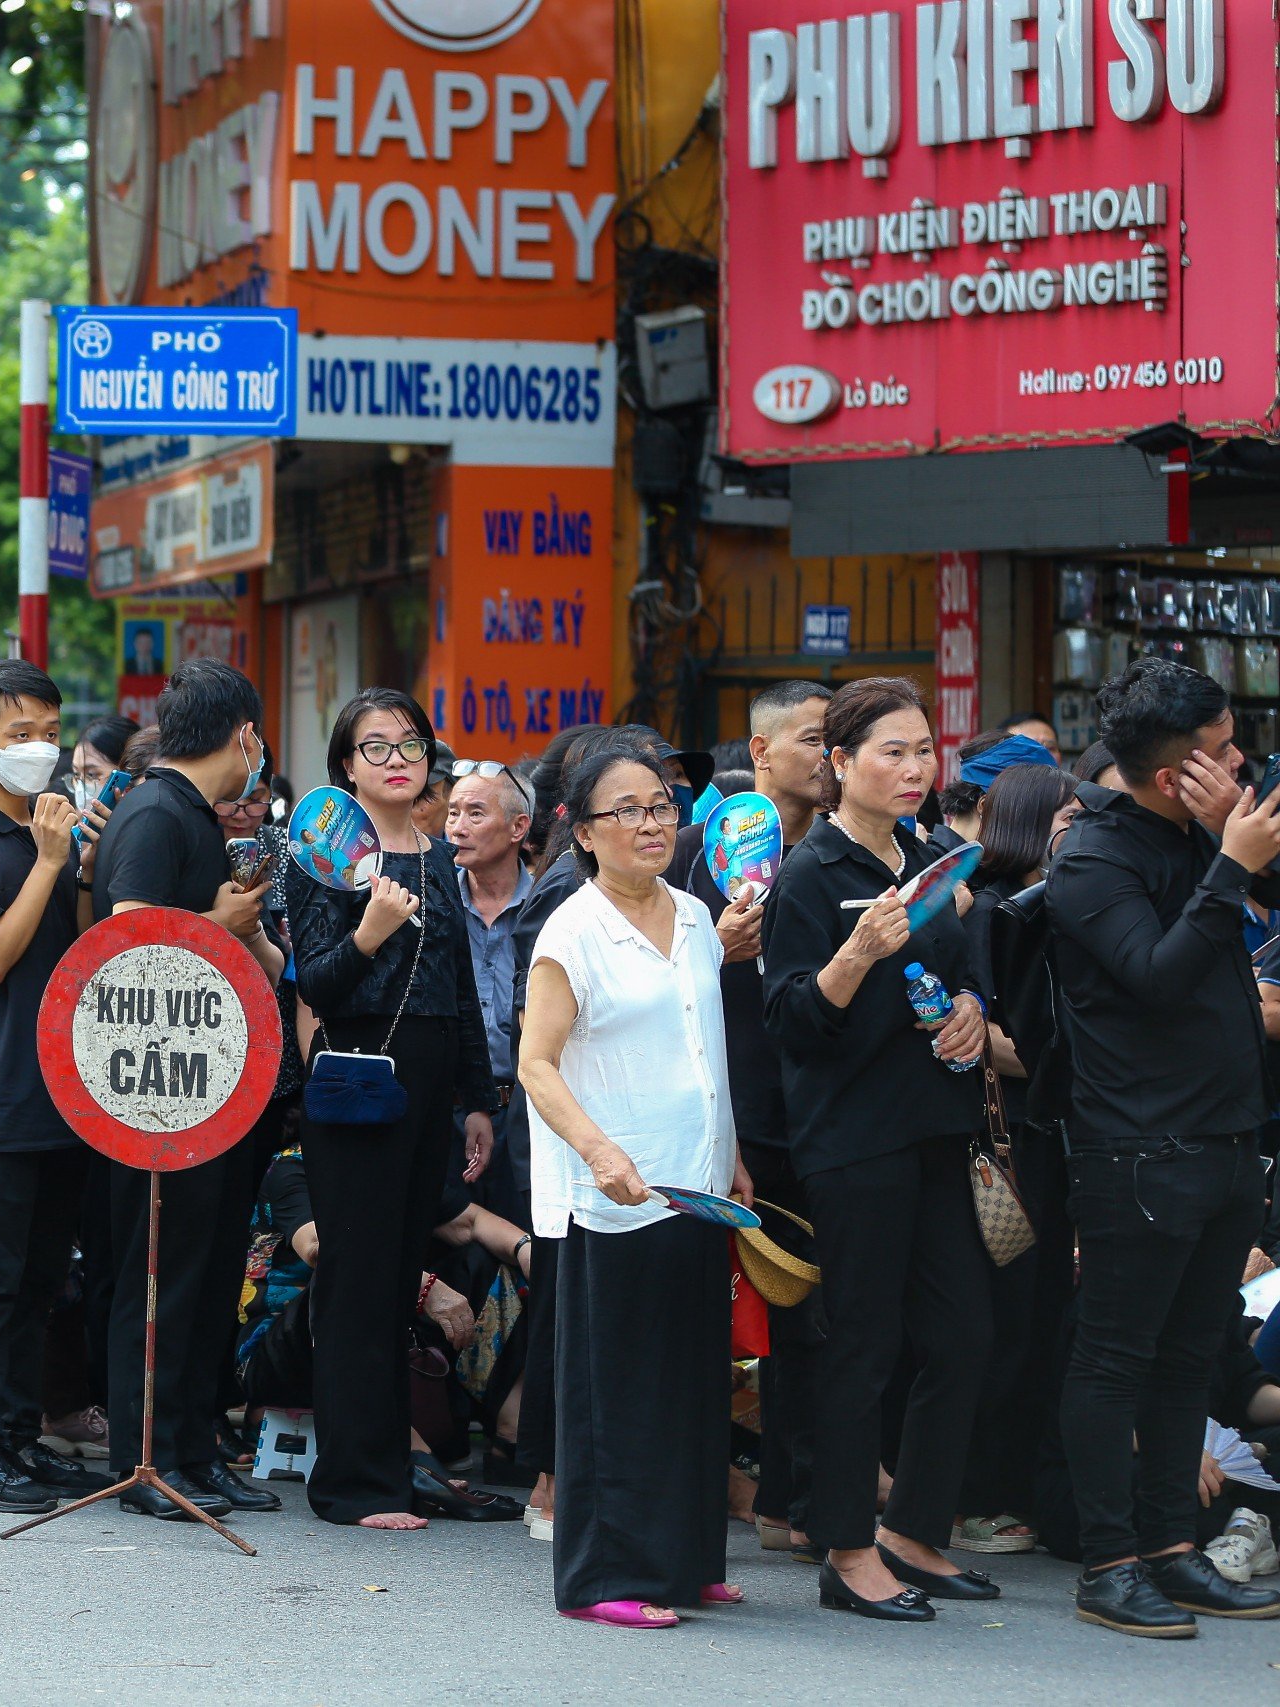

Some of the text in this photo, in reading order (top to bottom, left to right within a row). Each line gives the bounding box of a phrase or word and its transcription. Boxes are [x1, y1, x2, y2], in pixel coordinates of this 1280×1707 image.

[295, 64, 609, 168] HAPPY
[748, 12, 900, 178] PHỤ
[290, 180, 616, 282] MONEY
[803, 182, 1167, 269] PHỤ KIỆN ĐIỆN THOẠI
[801, 243, 1166, 331] ĐỒ CHƠI CÔNG NGHỆ
[151, 322, 223, 353] PHỐ
[79, 355, 279, 411] NGUYỄN CÔNG TRỨ
[772, 378, 813, 409] 117
[844, 377, 867, 409] Lò
[483, 510, 522, 556] VAY
[524, 687, 551, 734] XE
[558, 678, 605, 728] MÁY
[738, 809, 766, 833] IELTS
[740, 821, 768, 843] CAMP
[97, 986, 222, 1036] KHU VỰC
[109, 1036, 208, 1100] CẤM
